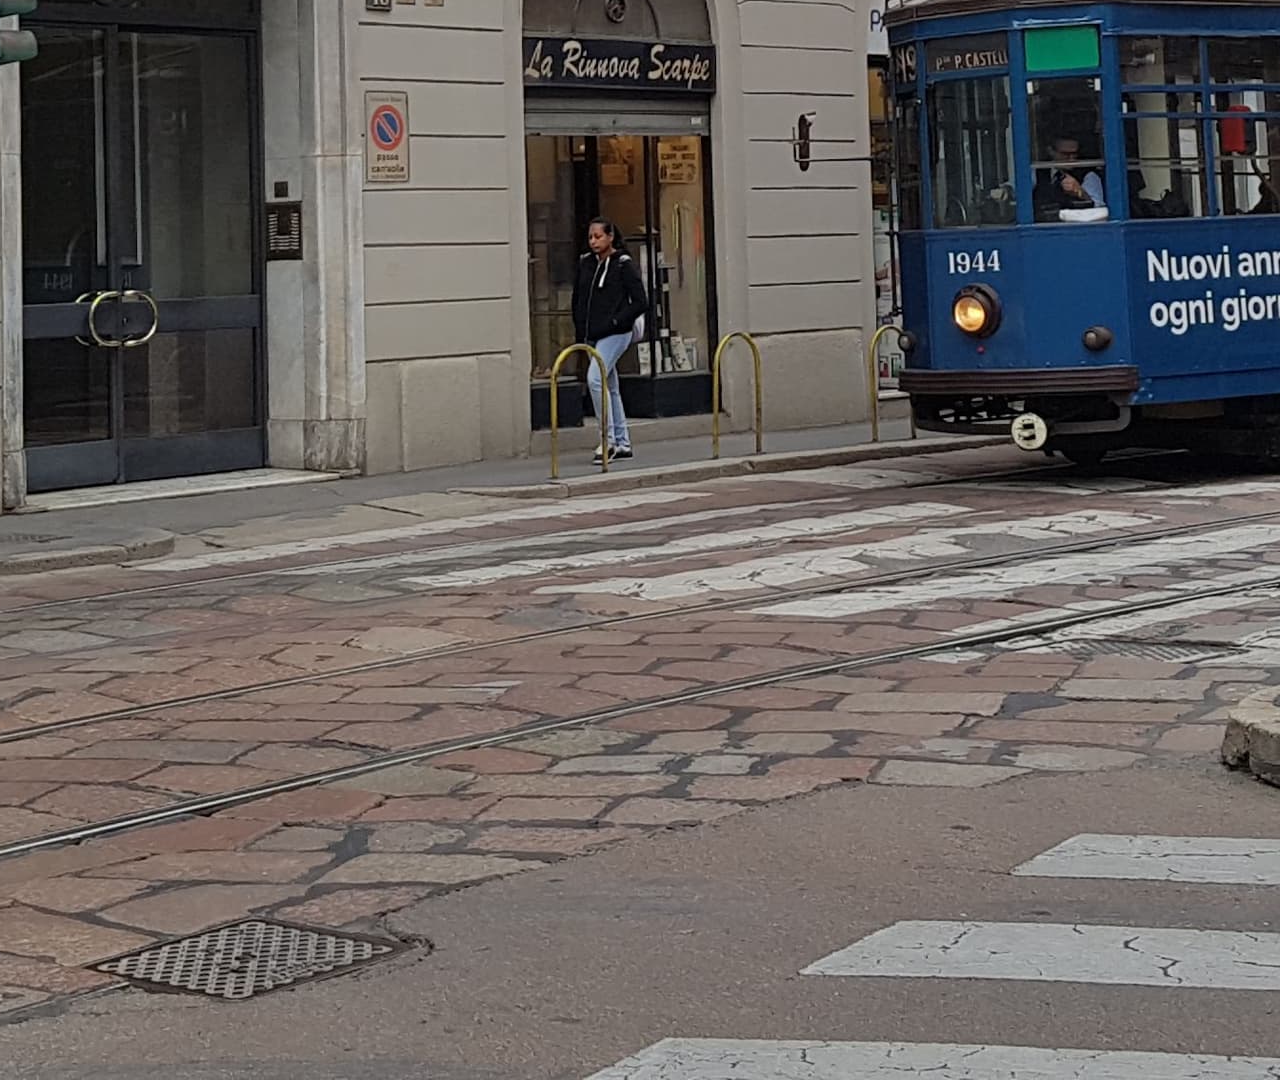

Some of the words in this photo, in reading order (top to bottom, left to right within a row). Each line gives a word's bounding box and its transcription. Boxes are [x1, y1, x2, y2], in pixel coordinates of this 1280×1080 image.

[525, 39, 553, 78] La
[562, 40, 641, 79] Rinnova
[648, 44, 710, 89] Scarpe
[948, 249, 1001, 274] 1944
[1146, 246, 1231, 282] Nuovi
[1149, 290, 1215, 335] ogni
